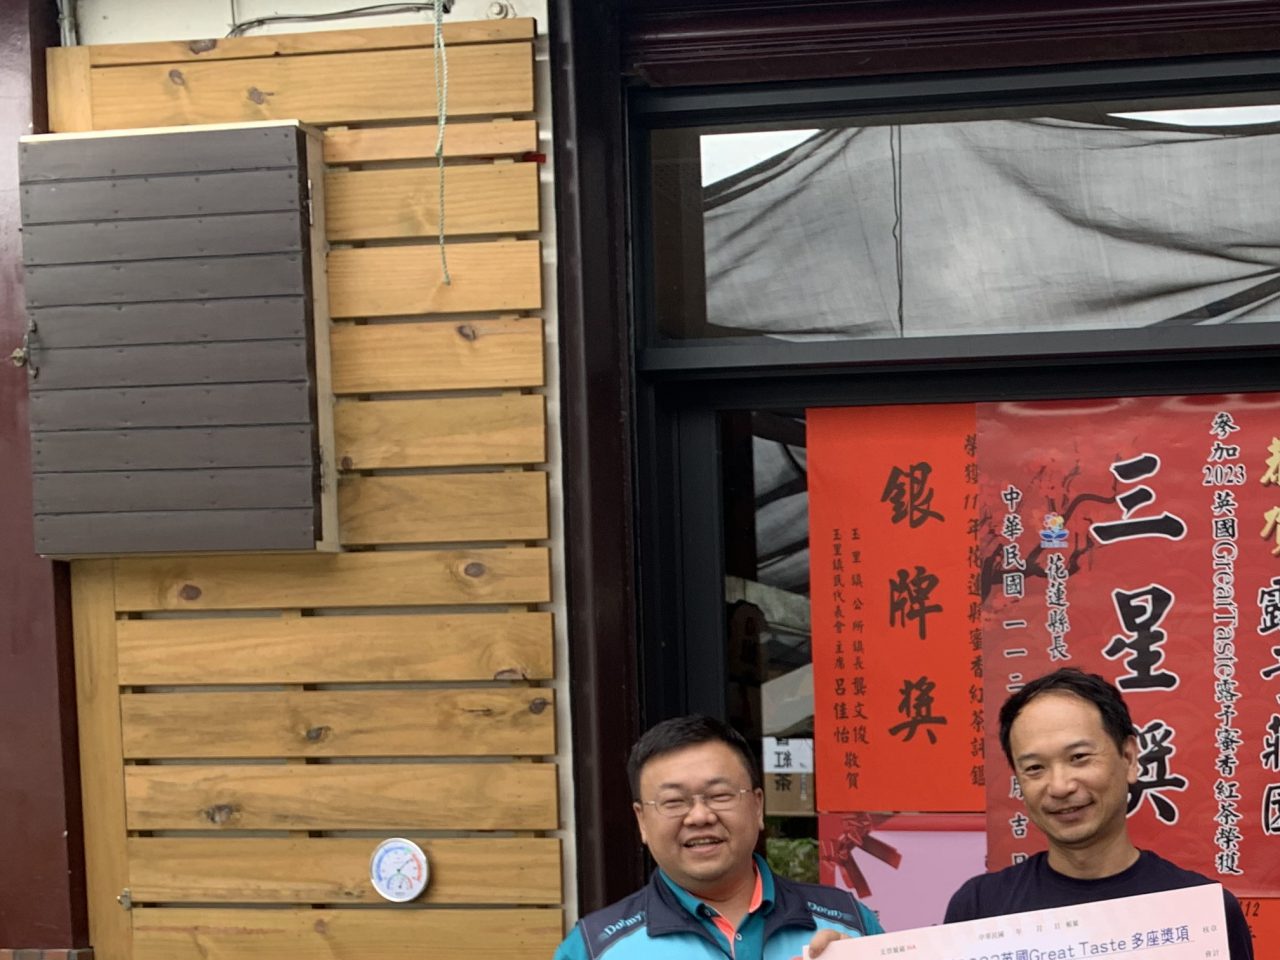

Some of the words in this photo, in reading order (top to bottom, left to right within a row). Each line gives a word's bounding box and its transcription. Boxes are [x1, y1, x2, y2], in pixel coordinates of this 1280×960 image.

[879, 461, 948, 745] 銀牌獎
[1047, 553, 1072, 661] 花蓮縣長
[844, 752, 861, 790] 敬賀
[1079, 936, 1127, 956] Taste
[1131, 925, 1190, 949] 多座獎項
